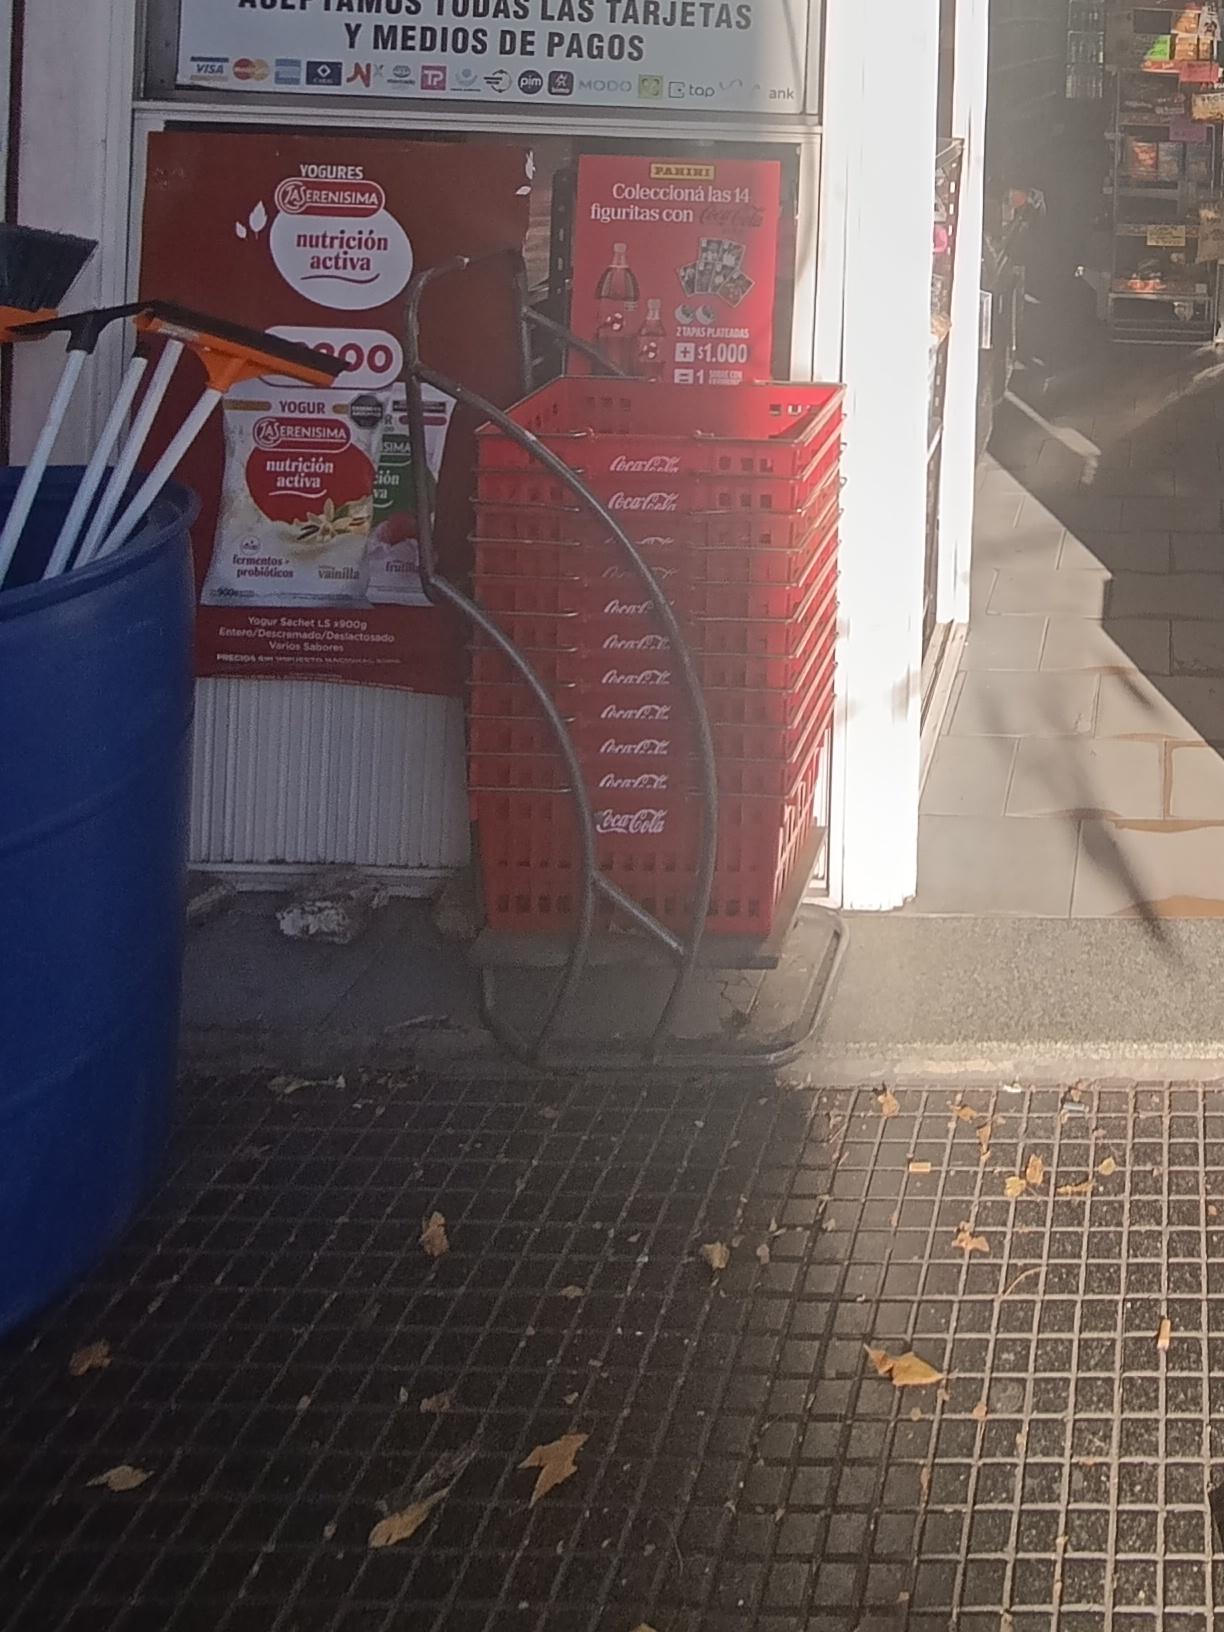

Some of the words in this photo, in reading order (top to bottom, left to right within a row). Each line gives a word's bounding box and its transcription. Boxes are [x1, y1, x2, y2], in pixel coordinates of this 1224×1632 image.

[345, 23, 362, 49] Y
[372, 23, 487, 55] MEDIOS
[500, 30, 535, 56] DE
[547, 32, 644, 62] PAGOS
[195, 63, 225, 75] VISA
[519, 75, 543, 90] pim
[578, 78, 632, 94] MODO
[299, 164, 364, 180] YOGURES
[653, 165, 712, 178] PANINI
[612, 182, 705, 203] Coleccioná
[707, 185, 732, 203] las
[734, 187, 750, 204] 14
[590, 203, 660, 223] figuritas
[662, 207, 694, 223] con
[296, 229, 389, 251] nutrición
[309, 253, 372, 271] activa
[697, 343, 748, 363] $1.000
[279, 400, 326, 414] YOGUR
[266, 457, 334, 473] nutrición
[276, 473, 321, 488] activa
[232, 555, 284, 566] fermentos
[236, 567, 294, 579] probióticos
[318, 567, 360, 580] vainilla
[248, 616, 278, 628] Yogur
[269, 640, 301, 651] Varios
[303, 642, 344, 653] Sabores
